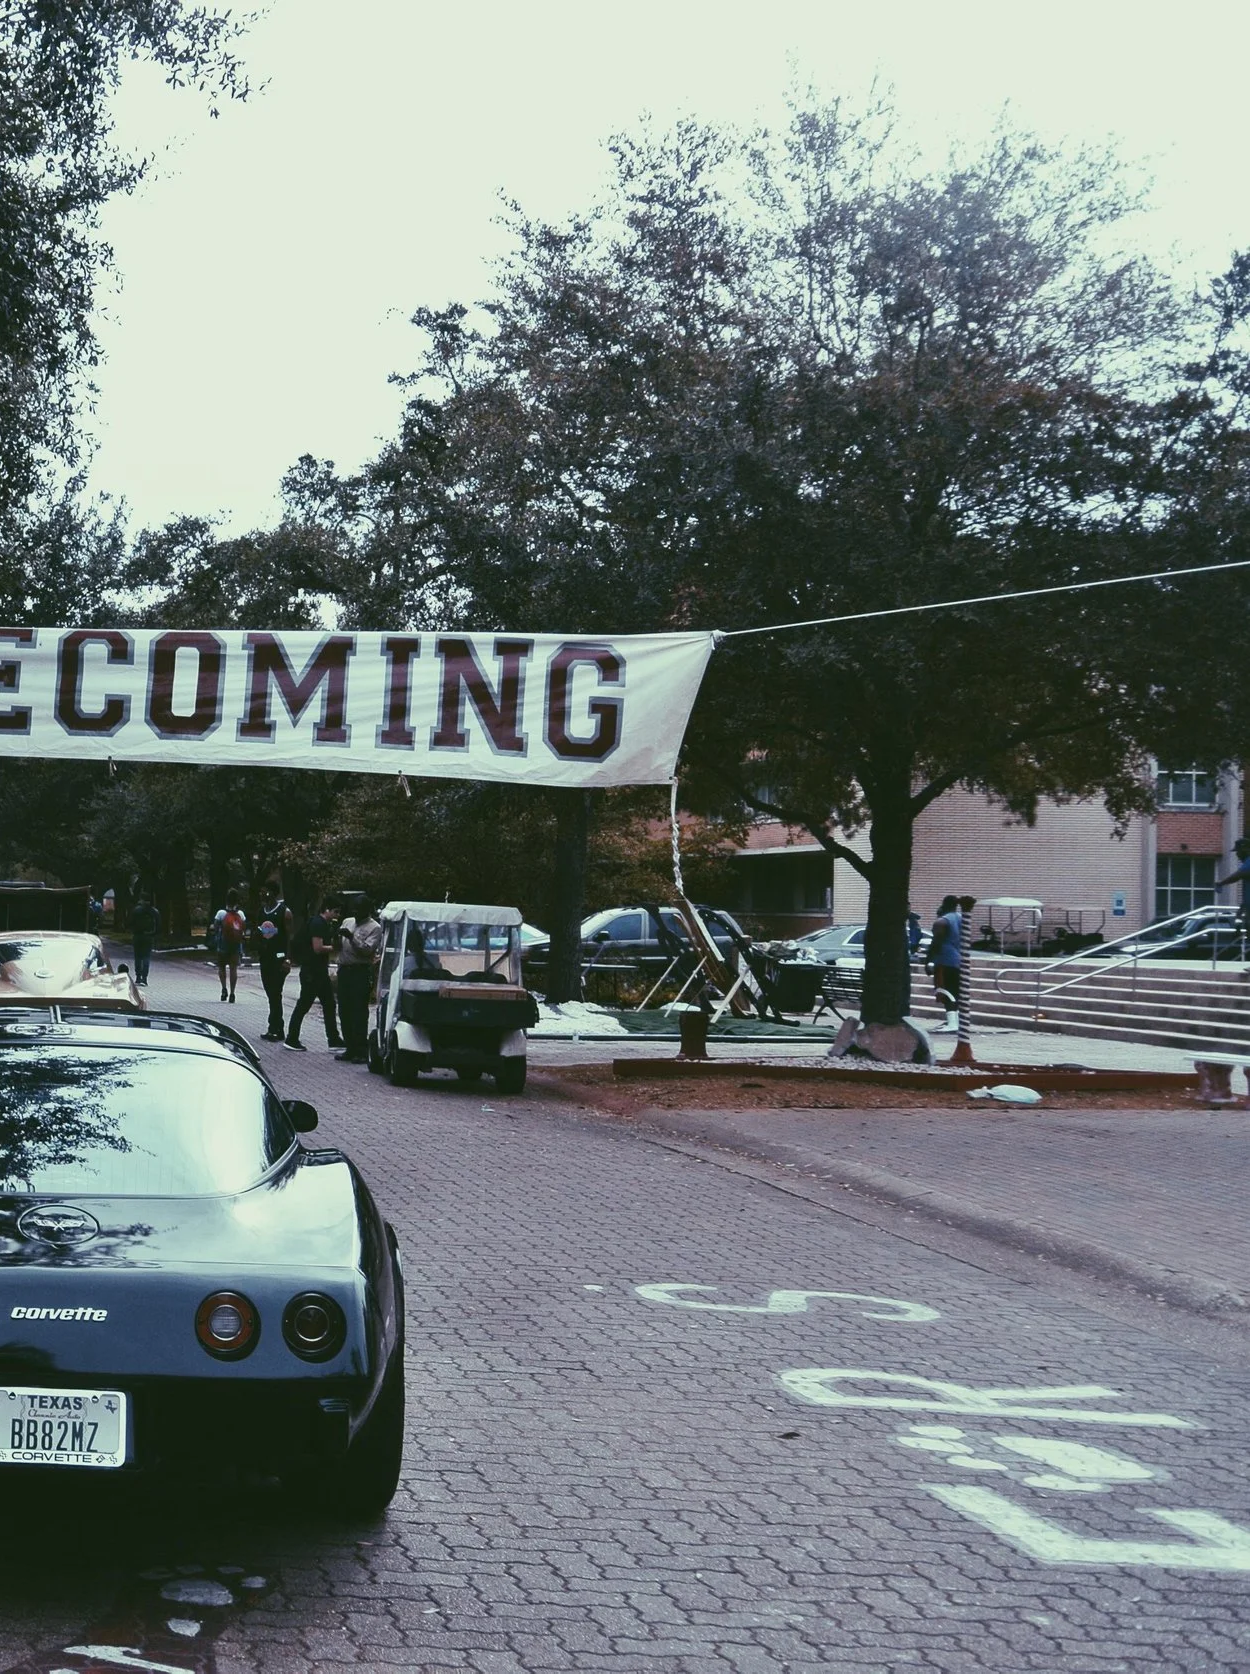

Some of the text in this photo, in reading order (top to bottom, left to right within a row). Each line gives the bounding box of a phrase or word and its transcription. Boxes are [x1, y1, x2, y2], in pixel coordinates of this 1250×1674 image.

[10, 1306, 108, 1322] corvette
[27, 1395, 84, 1411] TEXAS
[28, 1408, 81, 1420] Classic Auto
[10, 1418, 99, 1453] BB82MZ
[11, 1451, 92, 1463] CORVETTE
